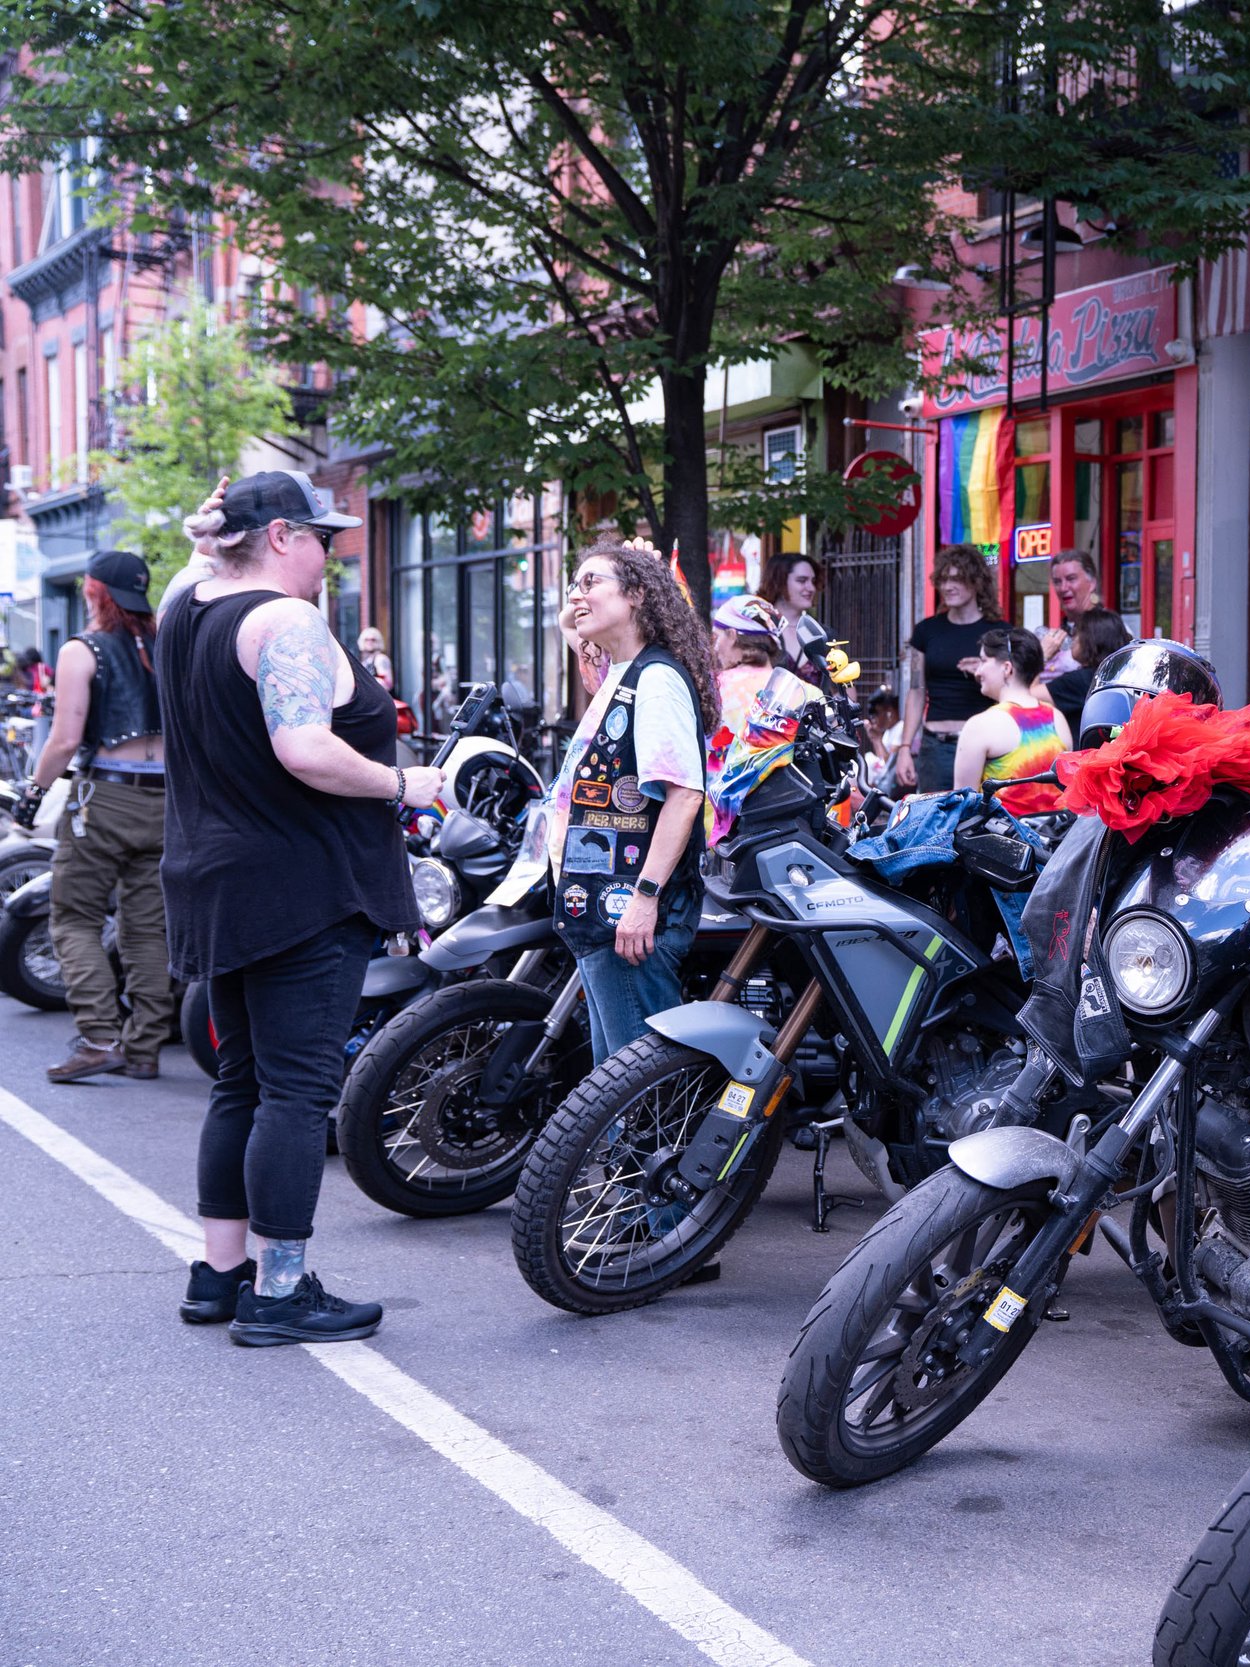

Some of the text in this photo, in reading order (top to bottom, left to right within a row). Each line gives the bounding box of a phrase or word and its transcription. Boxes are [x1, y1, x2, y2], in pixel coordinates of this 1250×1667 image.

[1065, 295, 1159, 385] Pizza
[1018, 529, 1052, 558] OPE
[600, 882, 621, 901] PROUD
[807, 895, 864, 911] CFMOTO
